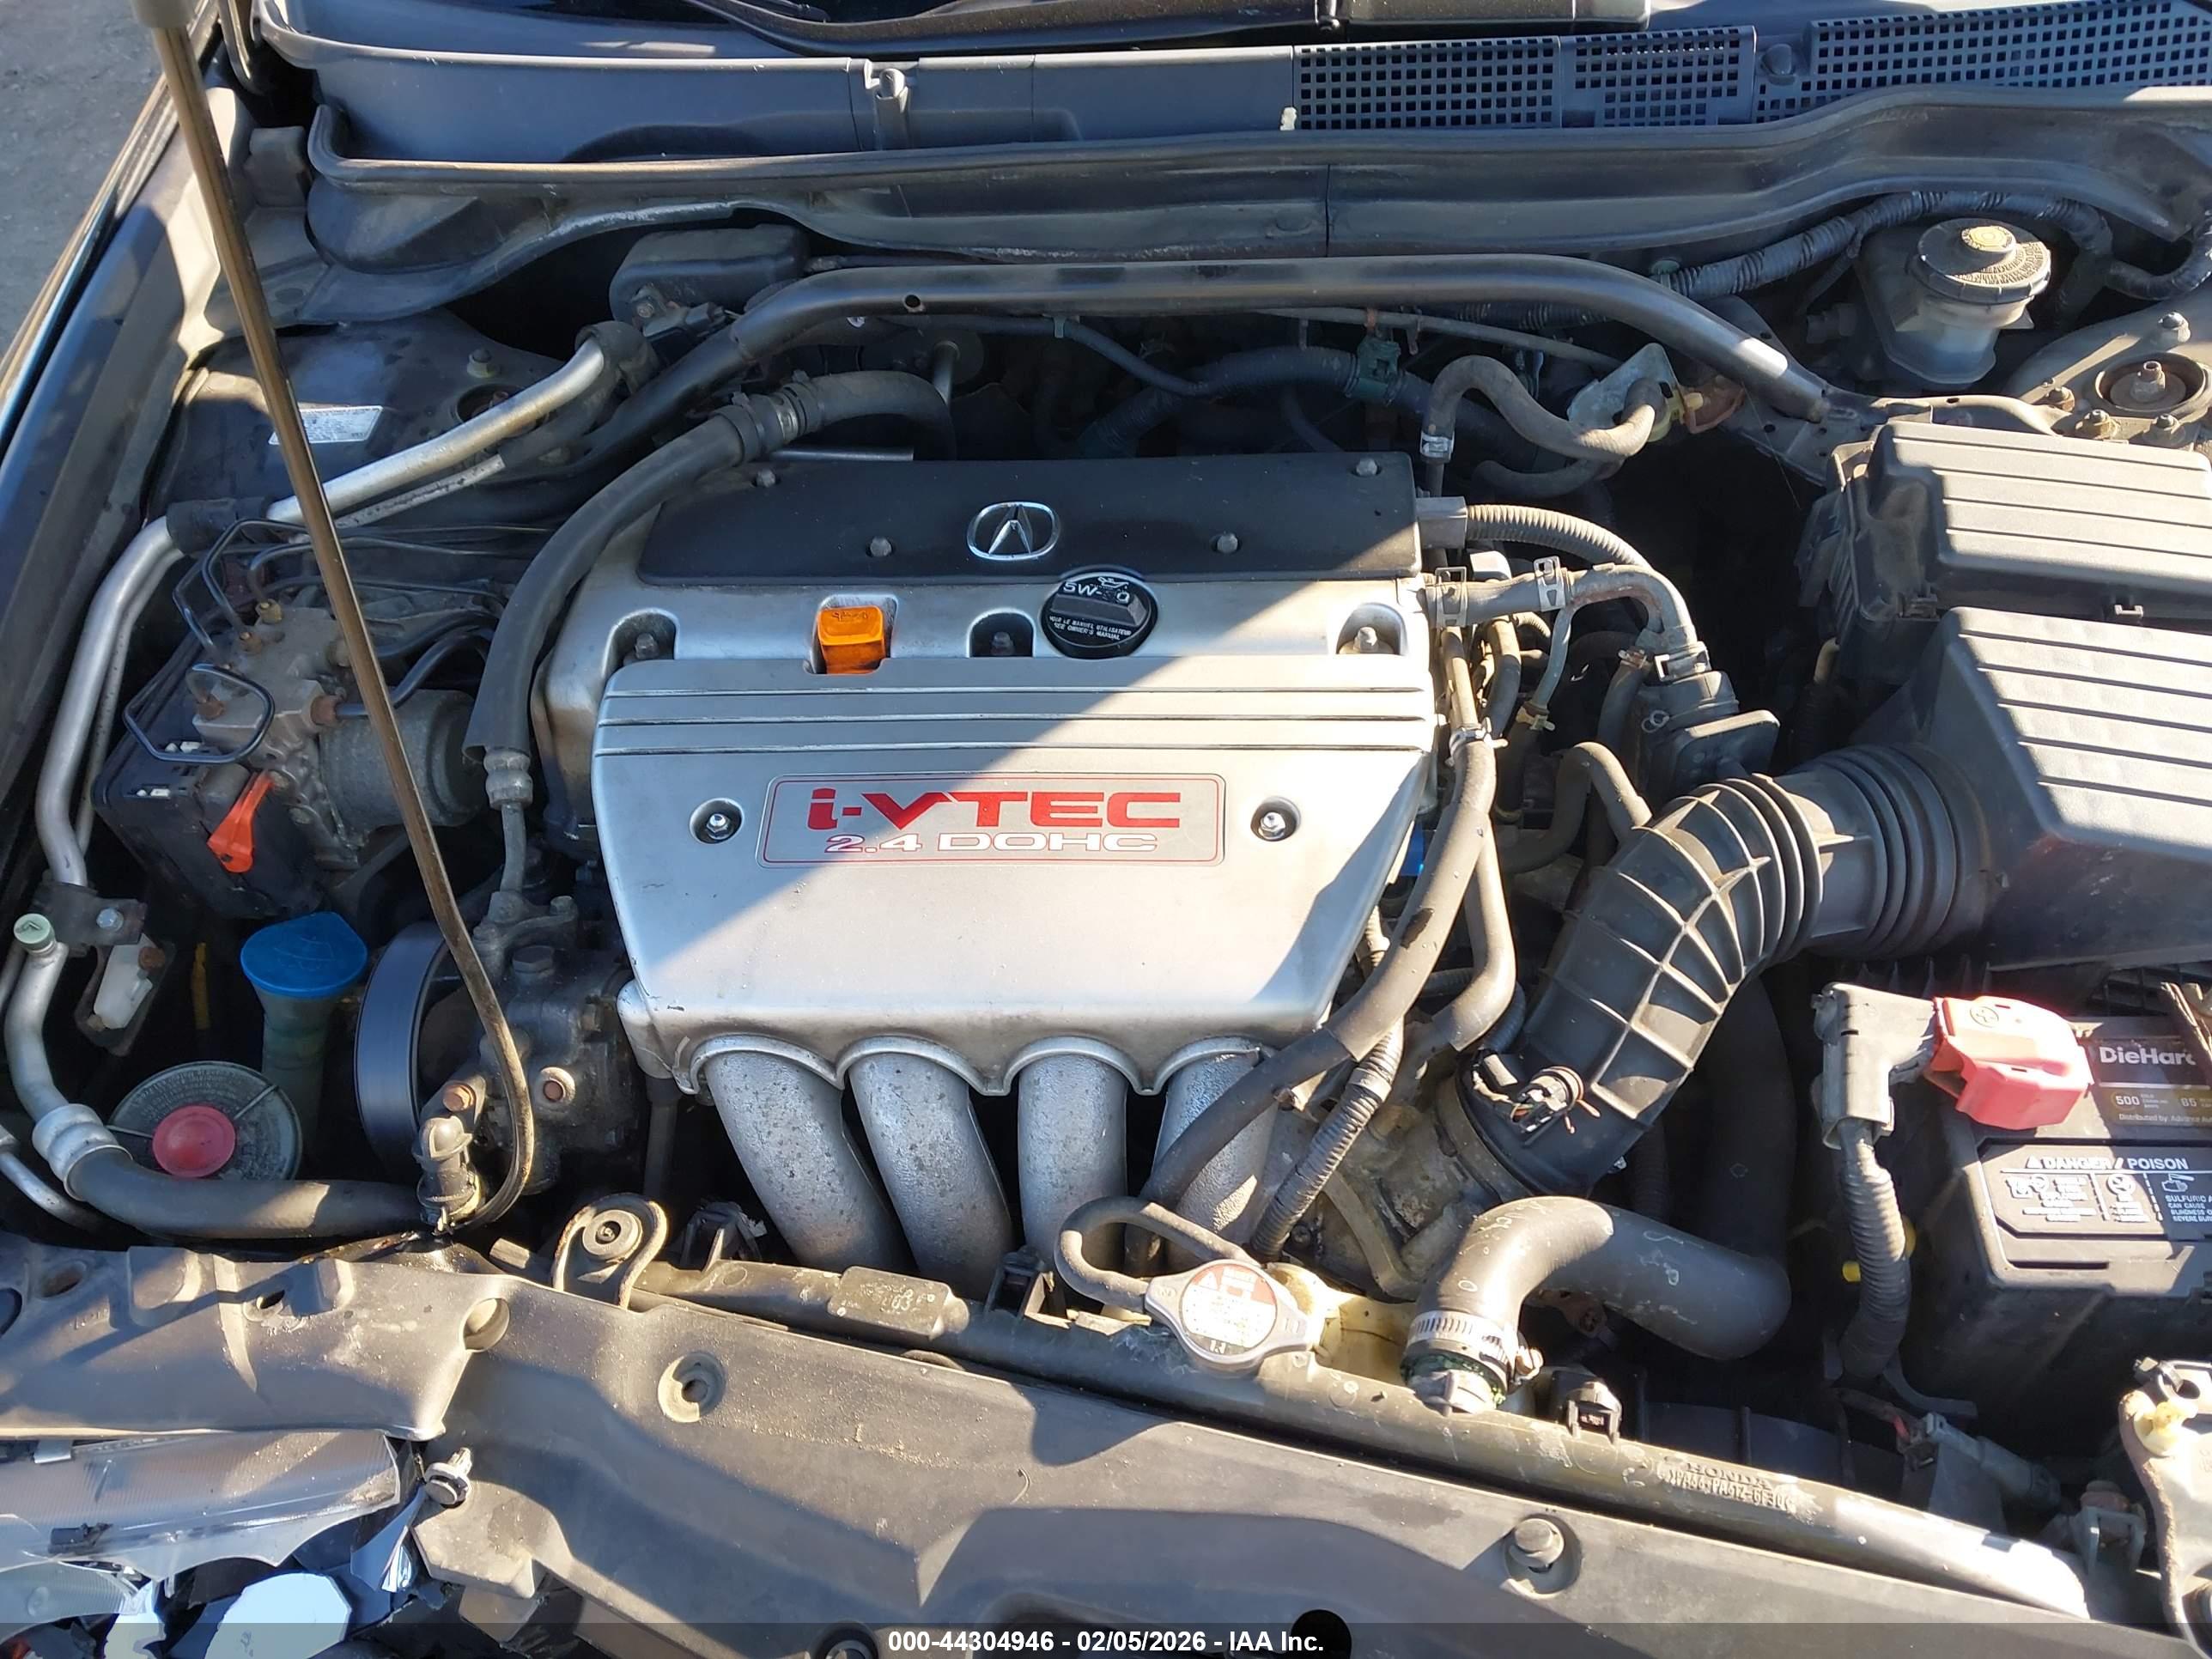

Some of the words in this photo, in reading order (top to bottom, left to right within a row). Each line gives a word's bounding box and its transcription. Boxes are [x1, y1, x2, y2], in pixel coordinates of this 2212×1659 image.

[1067, 624, 1094, 635] OWNER'S
[1097, 630, 1121, 641] MANUAL
[1072, 620, 1095, 629] MANUEL
[806, 787, 1182, 830] i-VTEC
[823, 832, 923, 854] 2.4
[937, 831, 1159, 853] DOHC
[2115, 1095, 2141, 1106] 500
[2043, 1156, 2113, 1170] DANGER
[2126, 1158, 2190, 1170] POISON
[1686, 1462, 1772, 1492] HONDA
